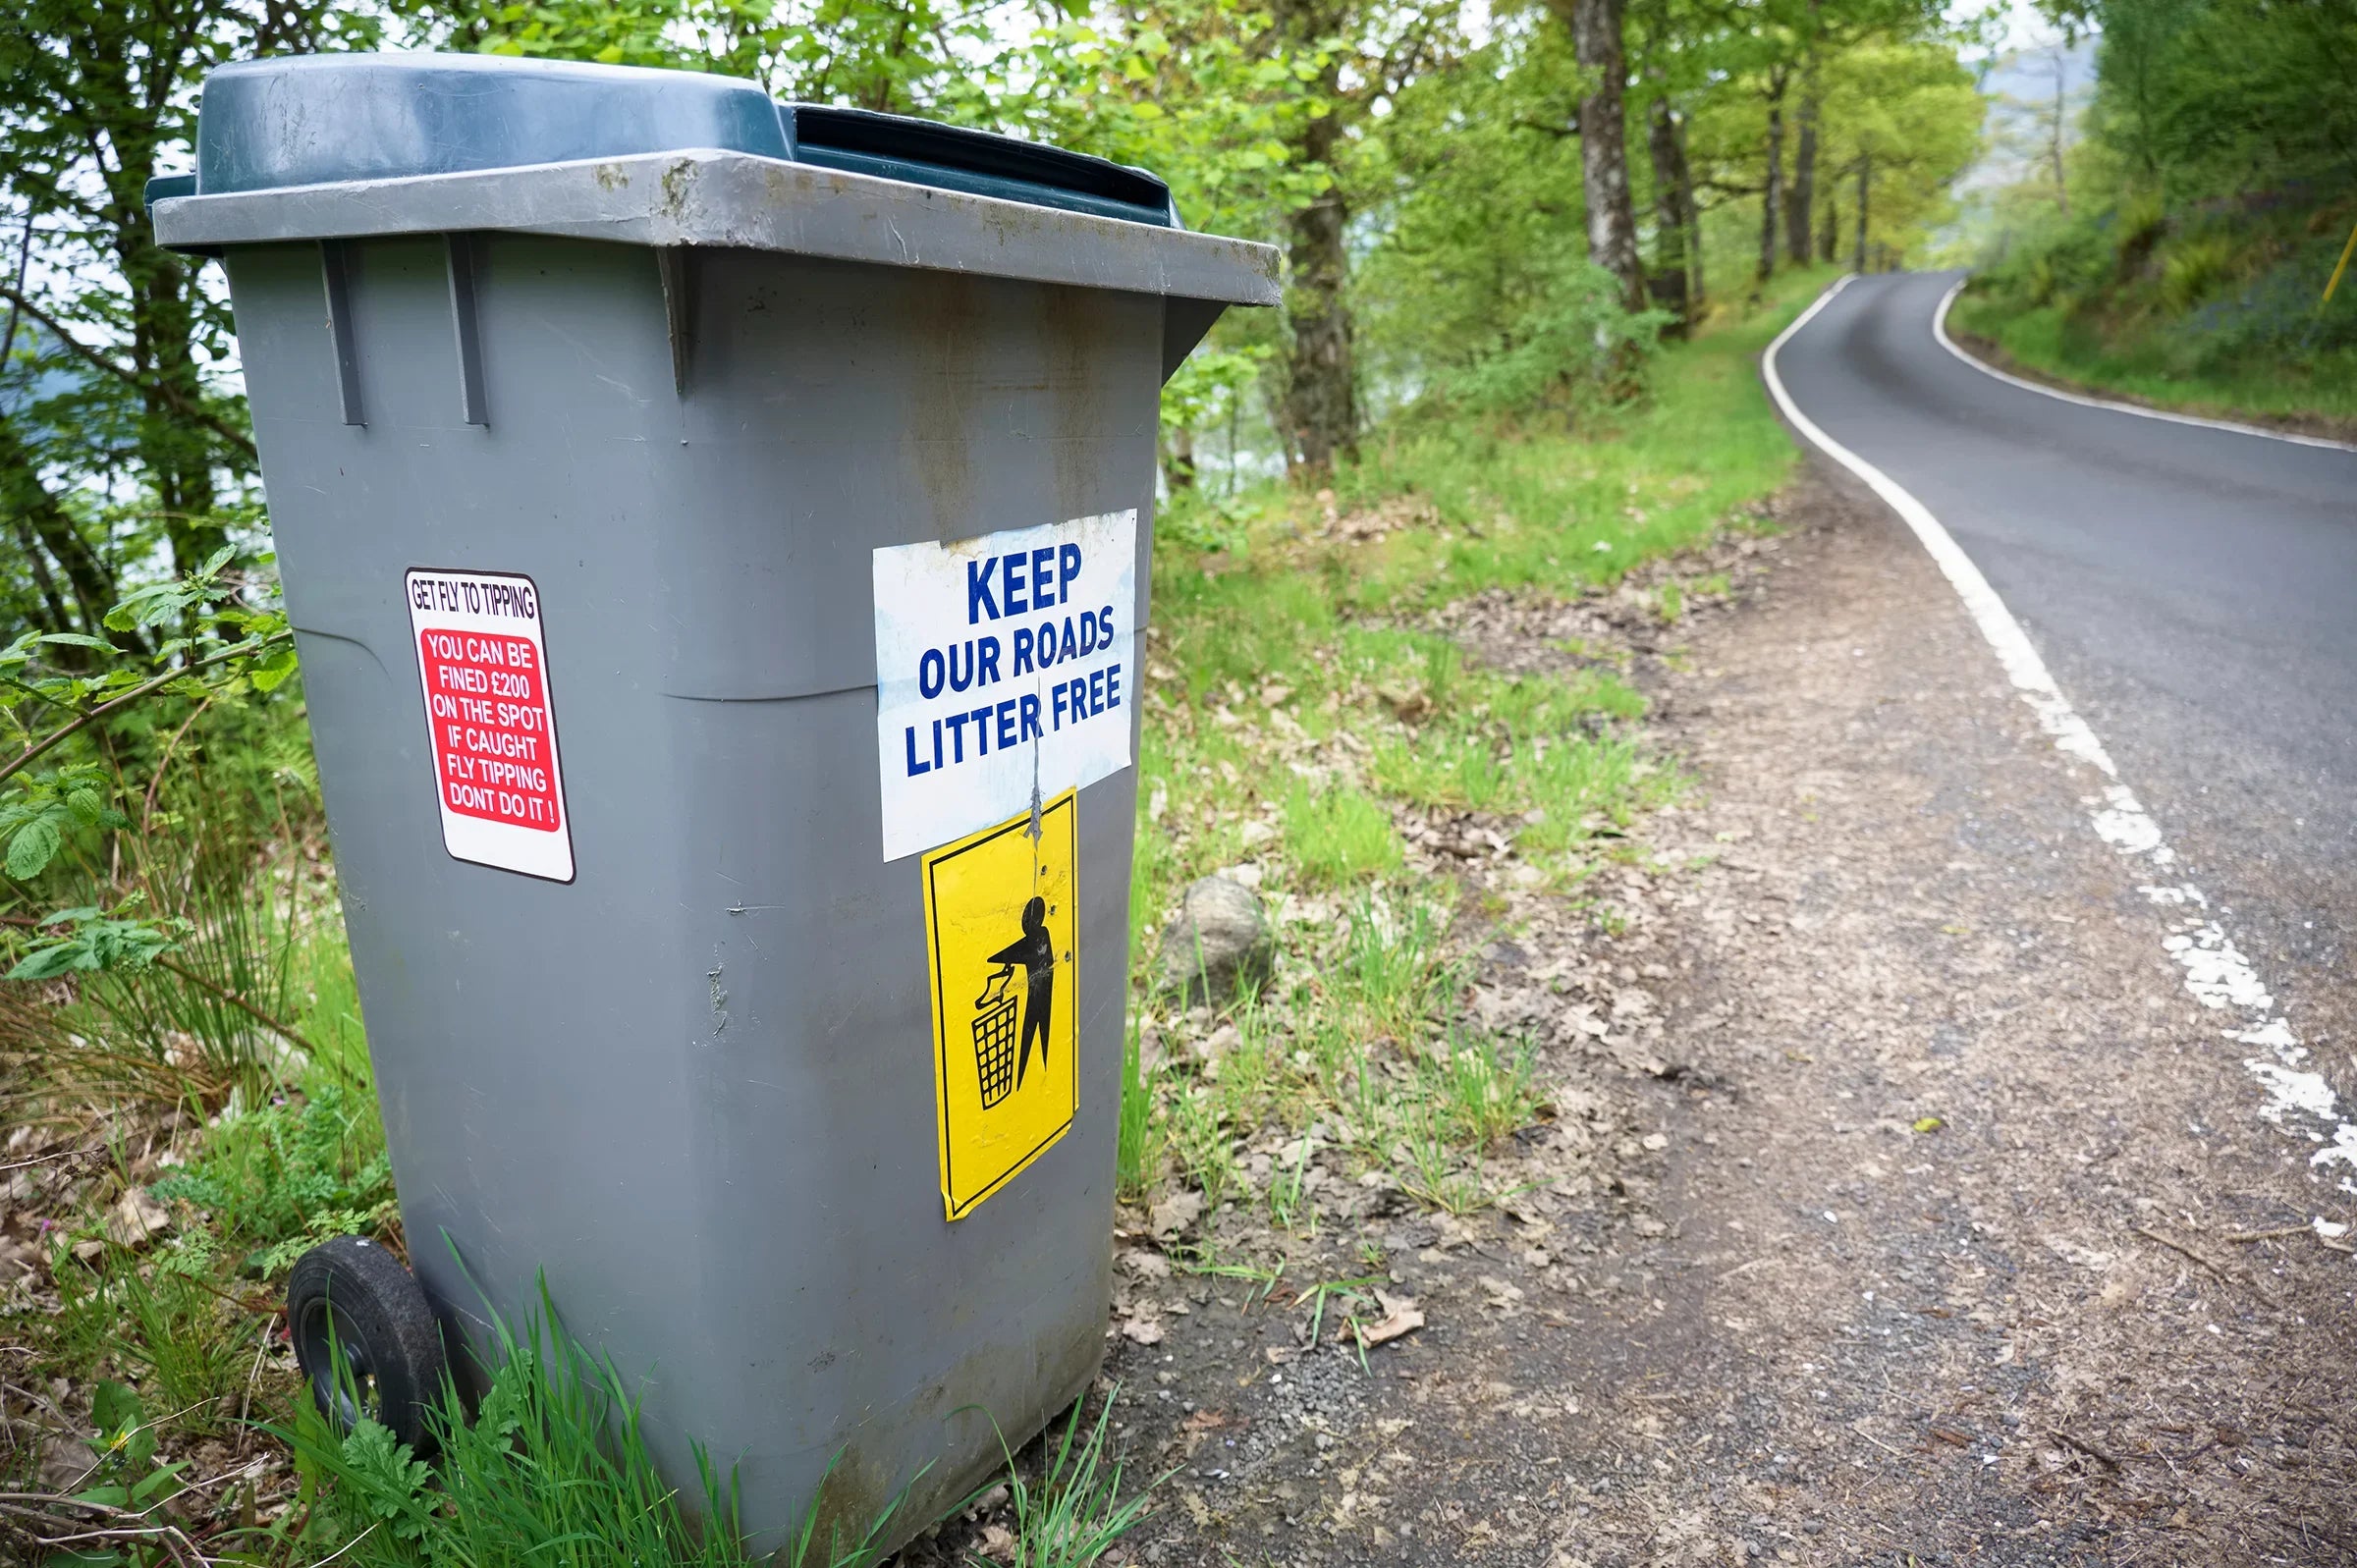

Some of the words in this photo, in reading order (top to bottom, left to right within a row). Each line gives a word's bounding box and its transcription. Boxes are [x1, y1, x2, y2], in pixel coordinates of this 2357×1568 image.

[411, 579, 435, 610] GET
[438, 581, 460, 612] FLY
[461, 582, 480, 614] TO
[481, 583, 535, 620] TIPPING
[967, 543, 1082, 624] KEEP
[426, 633, 464, 661] YOU
[466, 637, 503, 665] CAN
[508, 641, 533, 669] BE
[918, 635, 1001, 700] OUR
[1013, 605, 1114, 677] ROADS
[438, 666, 487, 693] FINED
[491, 671, 530, 699] £200
[433, 693, 458, 720] ON
[460, 697, 494, 725] THE
[498, 702, 543, 731] SPOT
[904, 693, 1044, 778] LITTER
[1052, 663, 1121, 732] FREE
[447, 725, 463, 748] IF
[466, 728, 537, 761] CAUGHT
[447, 753, 475, 780] FLY
[478, 758, 547, 791] TIPPING
[450, 783, 495, 811] DONT
[499, 791, 525, 818] DO
[528, 797, 544, 822] IT
